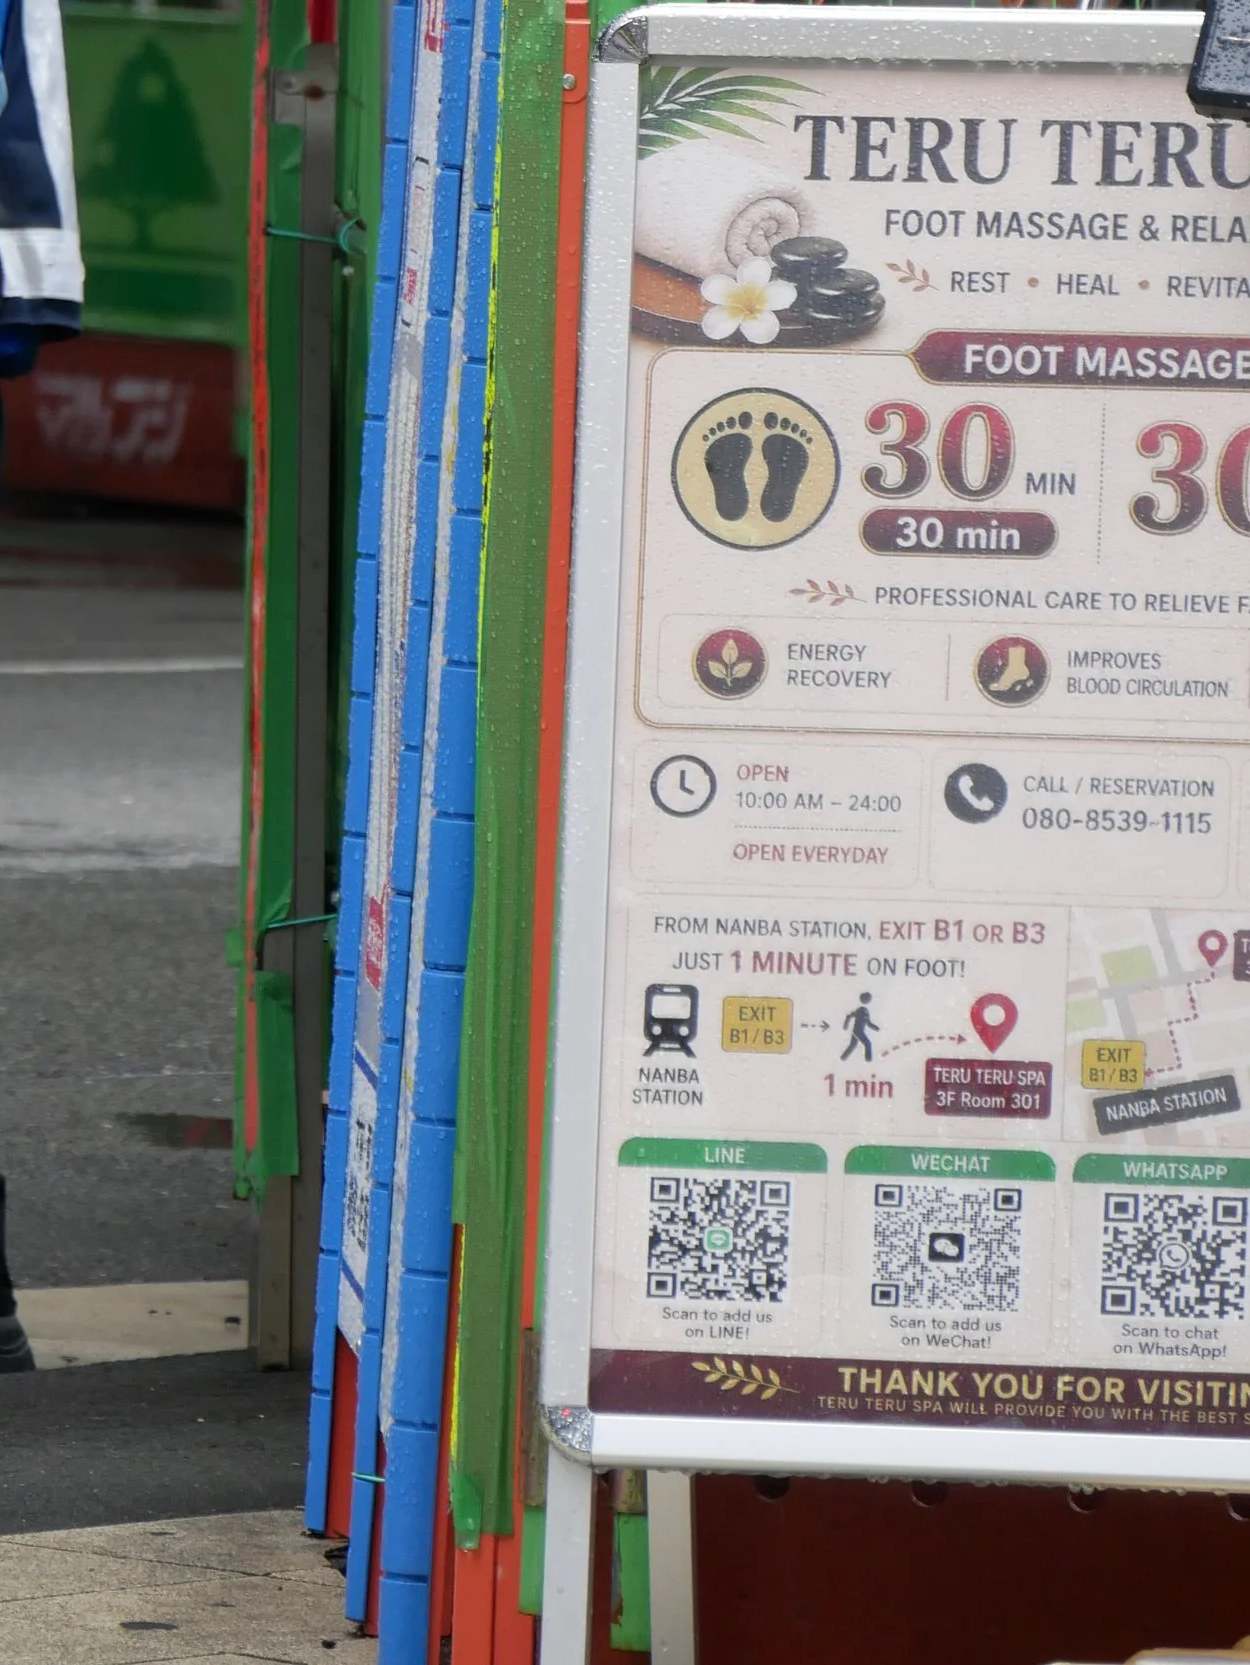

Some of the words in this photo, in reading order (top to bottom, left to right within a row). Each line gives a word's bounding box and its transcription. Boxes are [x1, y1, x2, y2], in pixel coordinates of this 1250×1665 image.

[794, 115, 1018, 184] TERU
[1040, 119, 1250, 190] TERU
[885, 209, 965, 237] FOOT
[977, 210, 1128, 241] MASSAGE
[1139, 214, 1159, 241] &
[1171, 215, 1250, 243] RELA
[951, 271, 1010, 293] REST
[1057, 274, 1119, 296] HEAL
[964, 343, 1064, 375] FOOT
[1076, 346, 1250, 379] MASSAGE
[860, 400, 1016, 502] 30
[1025, 472, 1076, 496] MIN
[896, 516, 946, 547] 30
[957, 519, 1020, 549] min
[875, 587, 1037, 610] PROFESSIONAL
[1045, 590, 1100, 611] CARE
[1110, 591, 1137, 612] TO
[1144, 593, 1230, 614] RELIEVE
[788, 643, 867, 664] ENERGY
[1067, 651, 1162, 671] IMPROVES
[787, 668, 892, 689] RECOVERY
[1066, 677, 1122, 697] BLOOD
[1126, 678, 1230, 699] CIRCULATION
[737, 764, 789, 784] OPEN
[1024, 775, 1067, 794] CALL
[1090, 777, 1215, 798] RESERVATION
[735, 791, 789, 812] 10:00
[794, 792, 824, 812] AM
[848, 793, 902, 813] 24:00
[1023, 806, 1212, 835] 080-8539-1115
[733, 843, 786, 864] OPEN
[792, 845, 889, 866] EVERYDAY
[654, 916, 709, 936] FROM
[716, 918, 782, 938] NANBA
[789, 919, 872, 942] STATION,
[880, 920, 925, 941] EXIT
[933, 919, 966, 943] B1
[973, 923, 1005, 943] OR
[1011, 921, 1046, 945] B3
[672, 952, 724, 972] JUST
[731, 951, 743, 973] 1
[752, 951, 858, 976] MINUTE
[867, 957, 896, 976] ON
[904, 958, 965, 978] FOOT!
[738, 1006, 776, 1023] EXIT
[730, 1028, 748, 1044] B1
[764, 1029, 784, 1045] B3
[1096, 1046, 1131, 1063] EXIT
[639, 1067, 700, 1084] NANBA
[933, 1067, 971, 1085] TERU
[977, 1068, 1013, 1086] TERU
[1017, 1071, 1046, 1087] SPA
[632, 1088, 703, 1106] STATION
[824, 1074, 836, 1097] 1
[844, 1074, 894, 1099] min
[936, 1091, 955, 1107] 3F
[961, 1092, 1003, 1109] Room
[1012, 1093, 1041, 1110] 301
[1105, 1098, 1161, 1123] NANBA
[1163, 1087, 1228, 1113] STATION
[704, 1147, 746, 1165] LINE
[911, 1153, 991, 1174] WECHAT
[1123, 1160, 1228, 1181] WHATSAPP
[662, 1306, 698, 1323] Scan
[702, 1308, 718, 1323] to
[722, 1308, 752, 1324] add
[756, 1314, 773, 1324] us
[889, 1315, 925, 1331] Scan
[929, 1317, 945, 1331] to
[950, 1317, 980, 1332] add
[984, 1321, 1002, 1333] us
[684, 1327, 704, 1338] on
[709, 1323, 750, 1339] LINE!
[901, 1335, 922, 1346] on
[925, 1332, 991, 1350] WeChat!
[1121, 1324, 1159, 1339] Scan
[1163, 1326, 1180, 1339] to
[1184, 1326, 1219, 1340] chat
[1113, 1343, 1134, 1354] on
[1138, 1341, 1227, 1361] WhatsApp!
[838, 1367, 961, 1397] THANK
[971, 1372, 1043, 1399] YOU
[1056, 1375, 1126, 1403] FOR
[818, 1396, 859, 1410] TERU
[865, 1397, 906, 1412] TERU
[911, 1399, 944, 1414] SPA
[949, 1401, 988, 1416] WILL
[994, 1403, 1066, 1419] PROVIDE
[1071, 1406, 1106, 1421] YOU
[1111, 1407, 1154, 1422] WITH
[1160, 1409, 1191, 1423] THE
[1197, 1411, 1237, 1425] BEST
